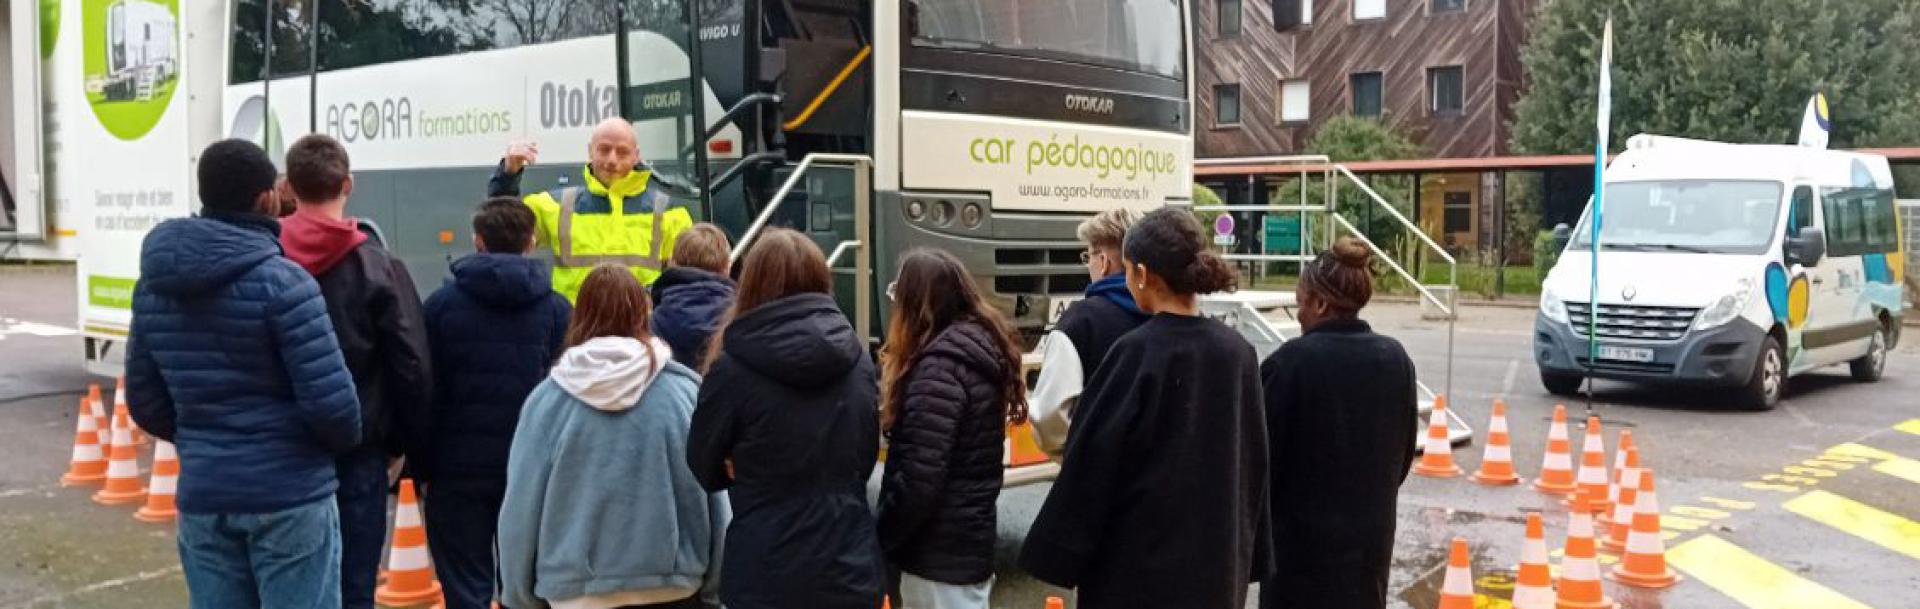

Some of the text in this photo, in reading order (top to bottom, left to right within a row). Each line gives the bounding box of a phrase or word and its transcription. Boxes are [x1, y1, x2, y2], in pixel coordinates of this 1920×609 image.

[643, 90, 681, 110] OTOKAR
[1065, 94, 1115, 114] OTOKAR
[327, 97, 511, 143] AGORA formations
[969, 133, 1176, 182] car pédagogique
[1018, 183, 1149, 202] www.agora-formations.fr
